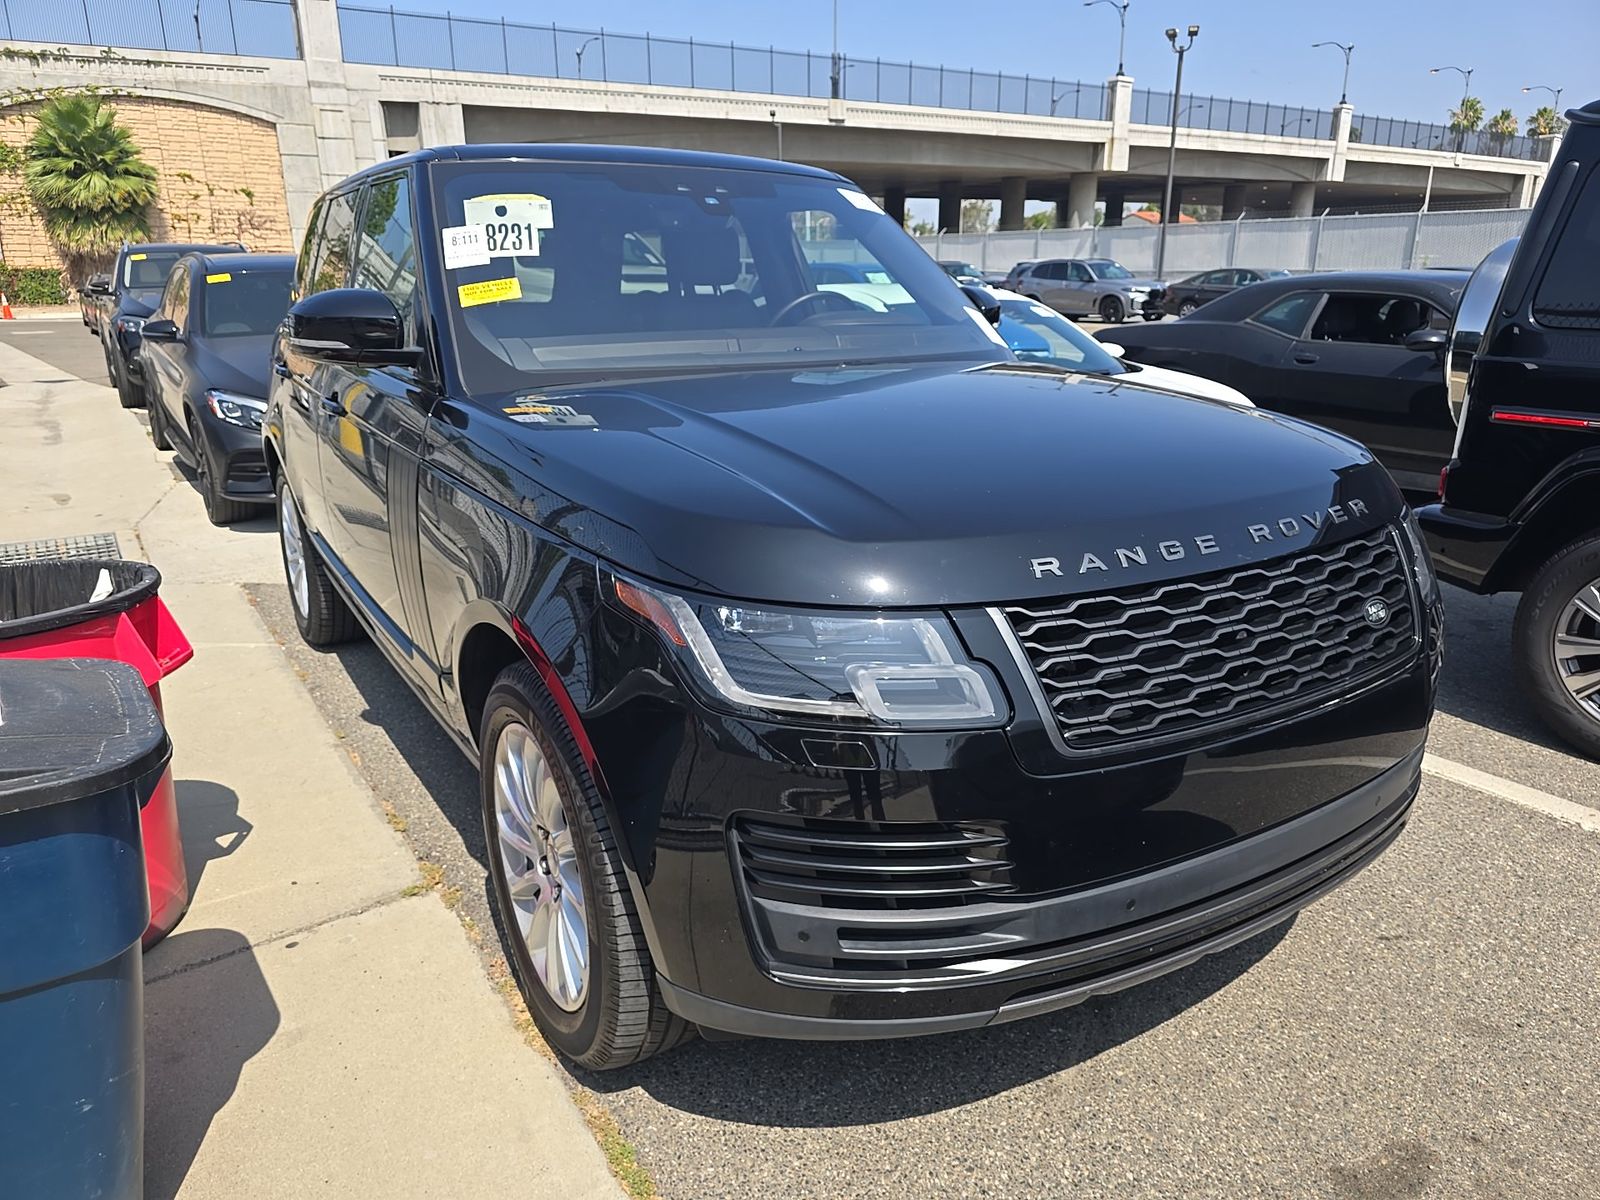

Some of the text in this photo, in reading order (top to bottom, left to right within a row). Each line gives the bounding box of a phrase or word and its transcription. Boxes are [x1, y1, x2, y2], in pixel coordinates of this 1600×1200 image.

[475, 223, 533, 251] 8231
[1030, 498, 1369, 579] RANGE ROVER
